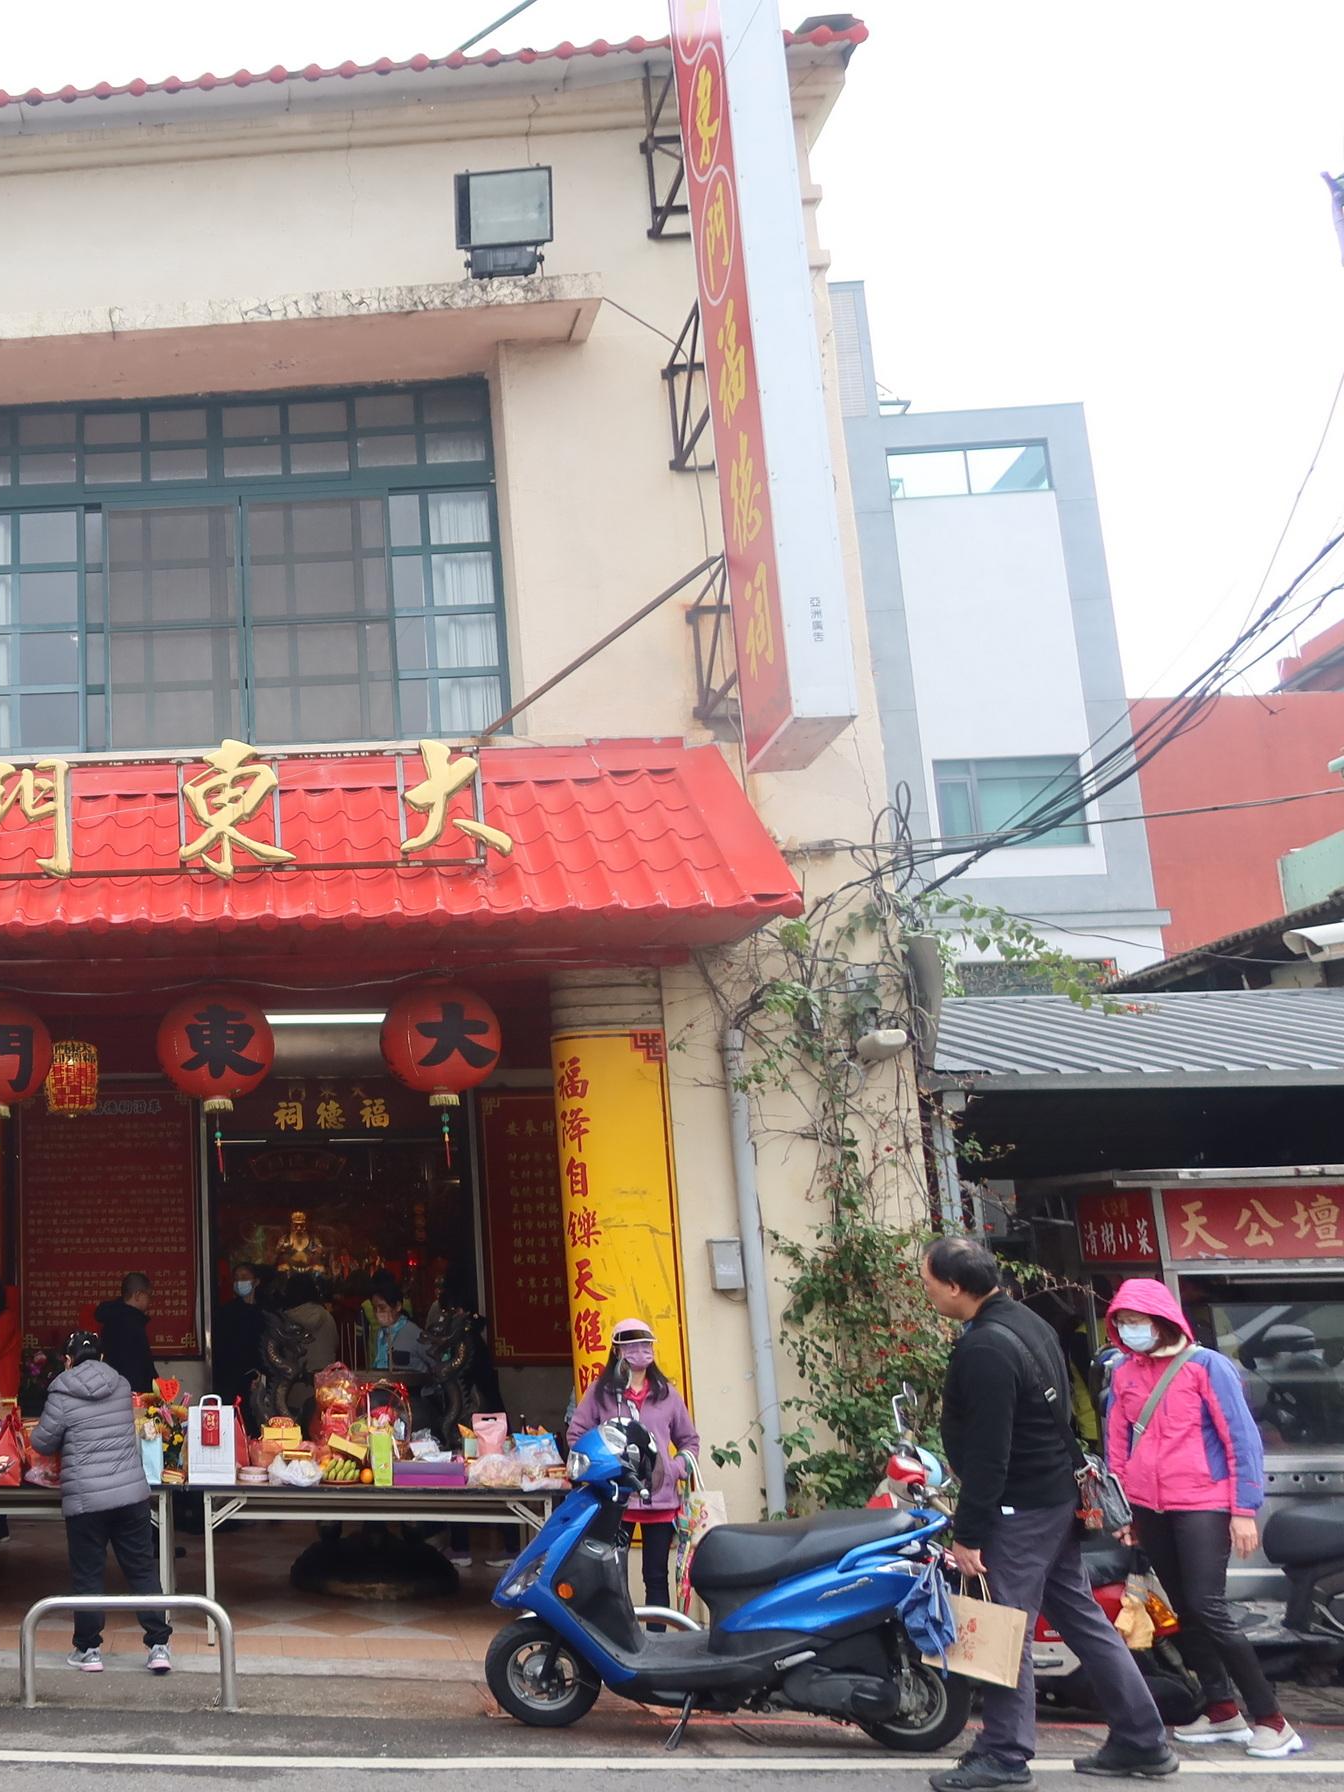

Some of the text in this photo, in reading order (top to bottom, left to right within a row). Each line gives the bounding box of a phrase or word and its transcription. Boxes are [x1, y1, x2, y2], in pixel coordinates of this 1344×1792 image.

[687, 0, 774, 682] 東門福德祠
[182, 1004, 266, 1078] 東
[416, 1002, 493, 1070] 大
[1180, 1193, 1344, 1250] 天公壇
